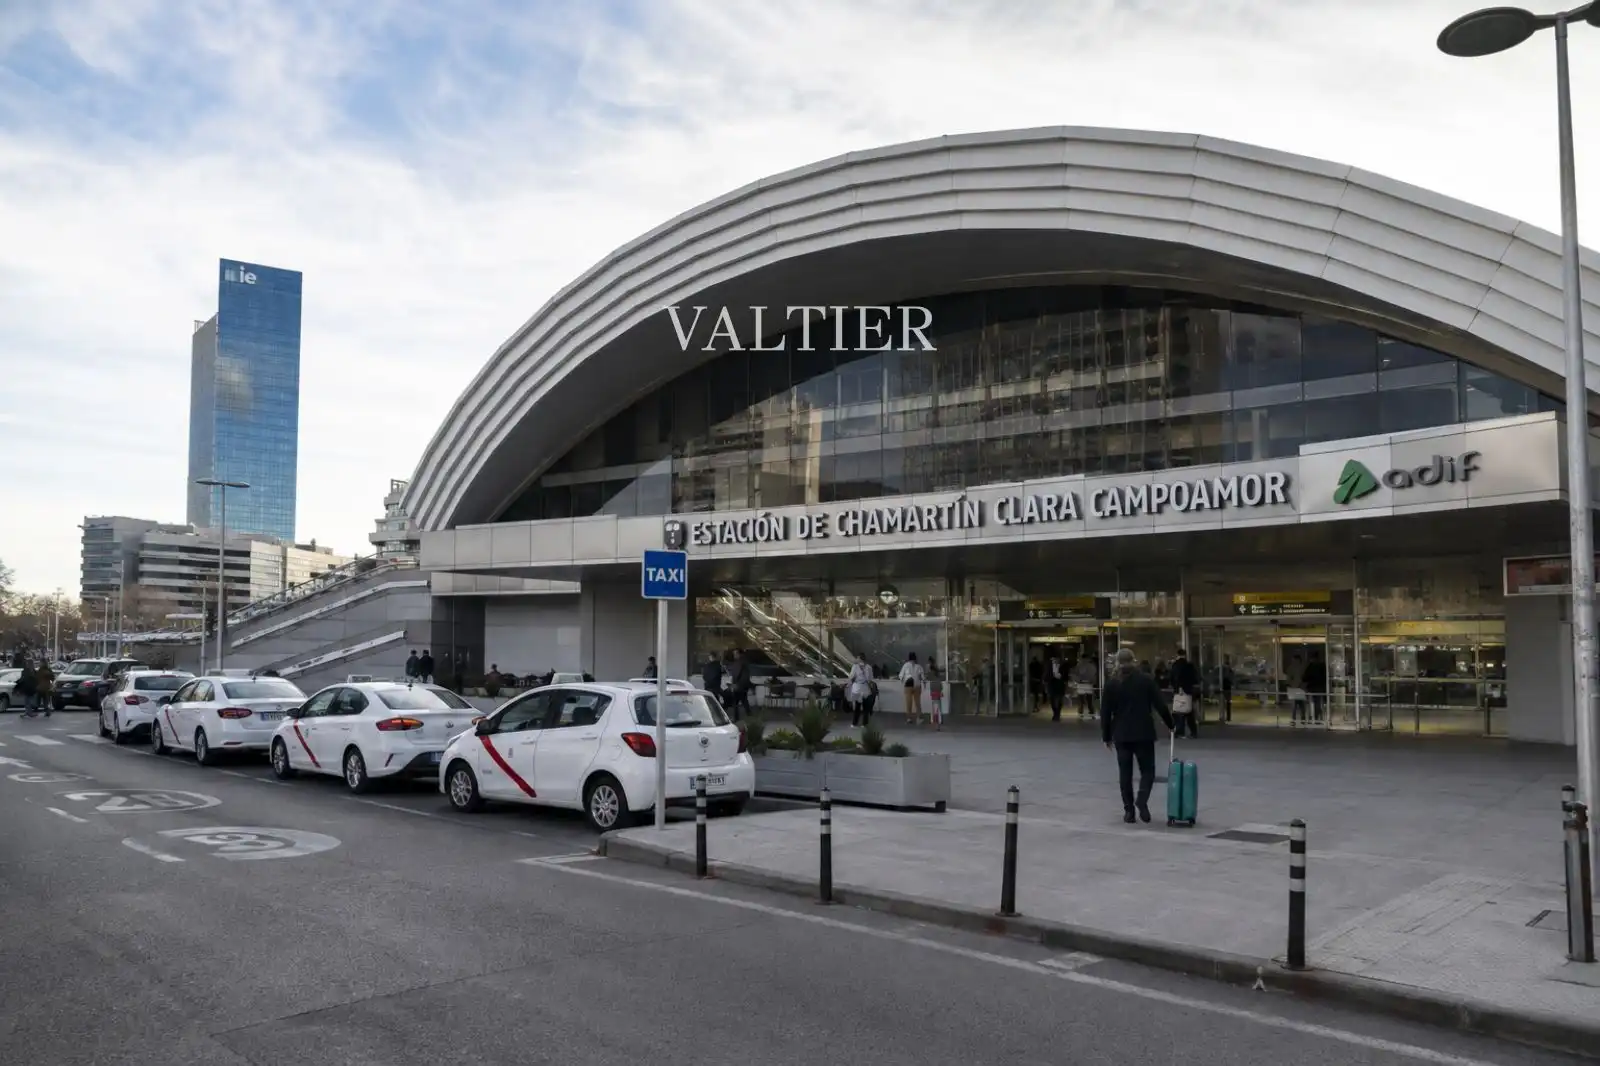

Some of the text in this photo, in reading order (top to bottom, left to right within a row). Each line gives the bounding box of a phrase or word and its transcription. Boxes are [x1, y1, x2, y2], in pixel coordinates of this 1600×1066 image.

[240, 265, 257, 285] ie
[1382, 451, 1481, 489] adif
[690, 472, 1287, 545] ESTACIÓN DE CHAMARTÍN CLARA CAMPOAMOR
[646, 567, 684, 583] TAXI
